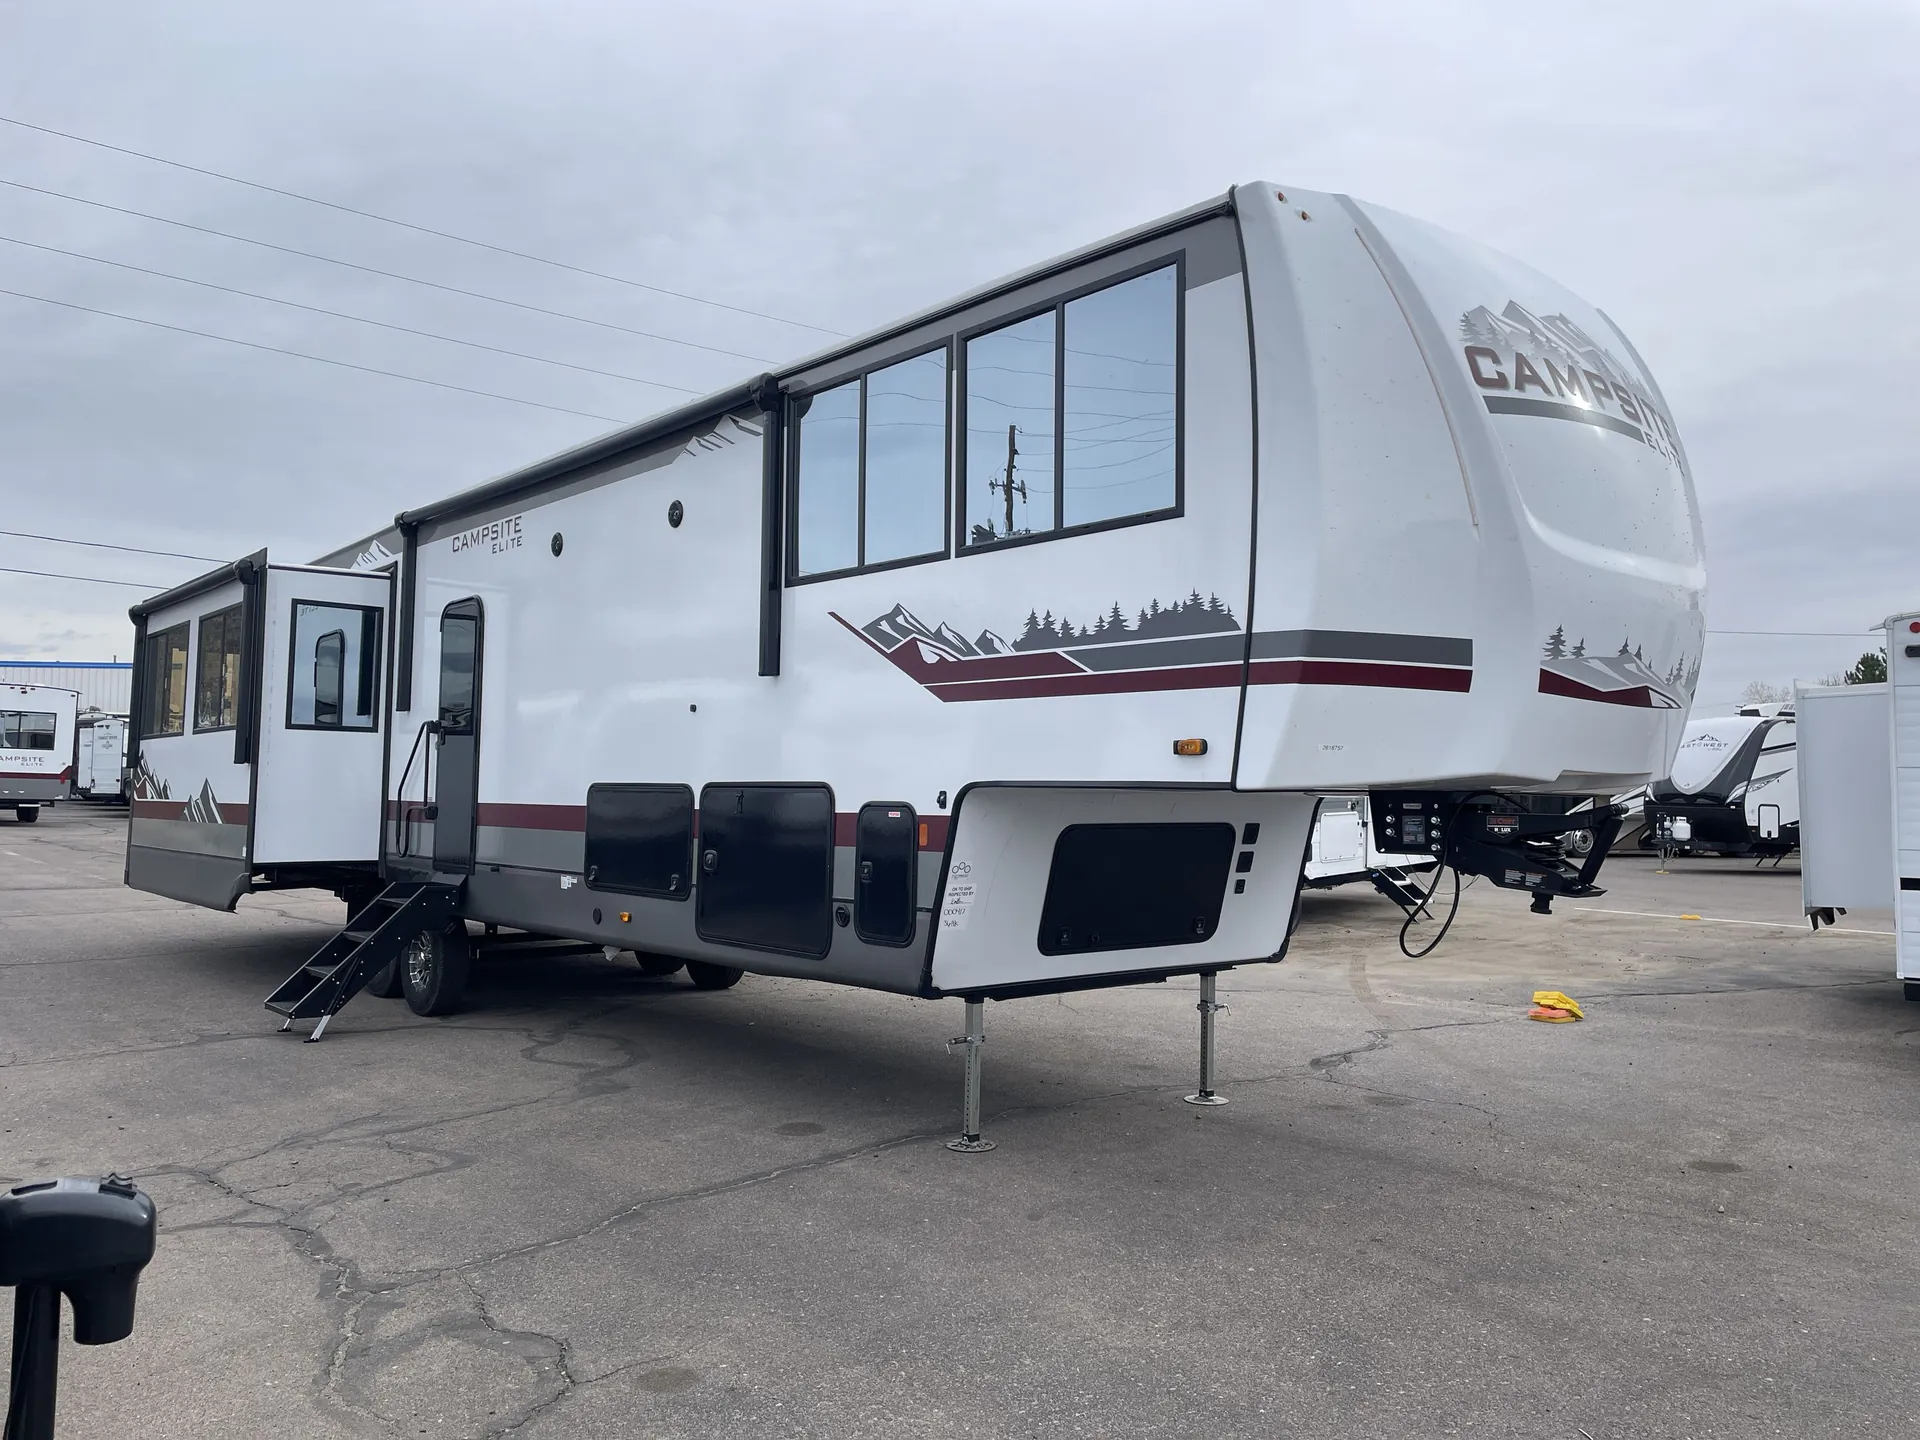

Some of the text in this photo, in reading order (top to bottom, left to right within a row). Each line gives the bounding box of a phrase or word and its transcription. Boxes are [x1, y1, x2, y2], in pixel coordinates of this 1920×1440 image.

[1464, 345, 1680, 458] CAMPSITE
[1643, 431, 1685, 477] ELITE
[452, 515, 523, 553] CAMPSITE
[491, 535, 523, 554] ELITE
[0, 755, 45, 763] AMPSITE
